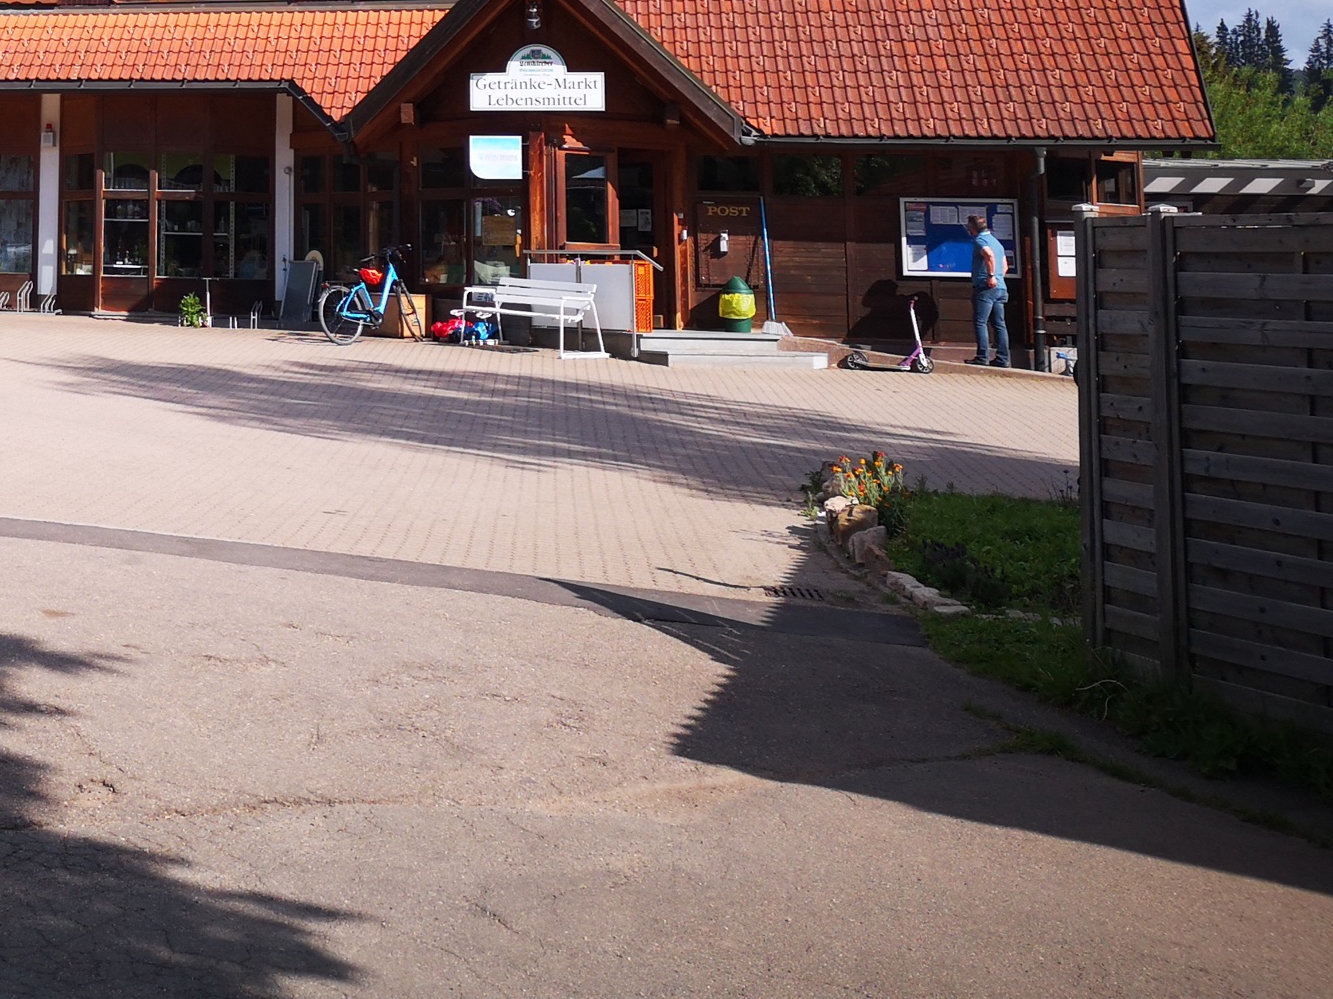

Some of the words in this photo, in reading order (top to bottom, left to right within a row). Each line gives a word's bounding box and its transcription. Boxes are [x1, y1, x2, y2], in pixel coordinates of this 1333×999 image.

[475, 77, 599, 91] Getränke-Markt
[487, 94, 587, 107] Lebensmittel
[706, 205, 751, 217] POST
